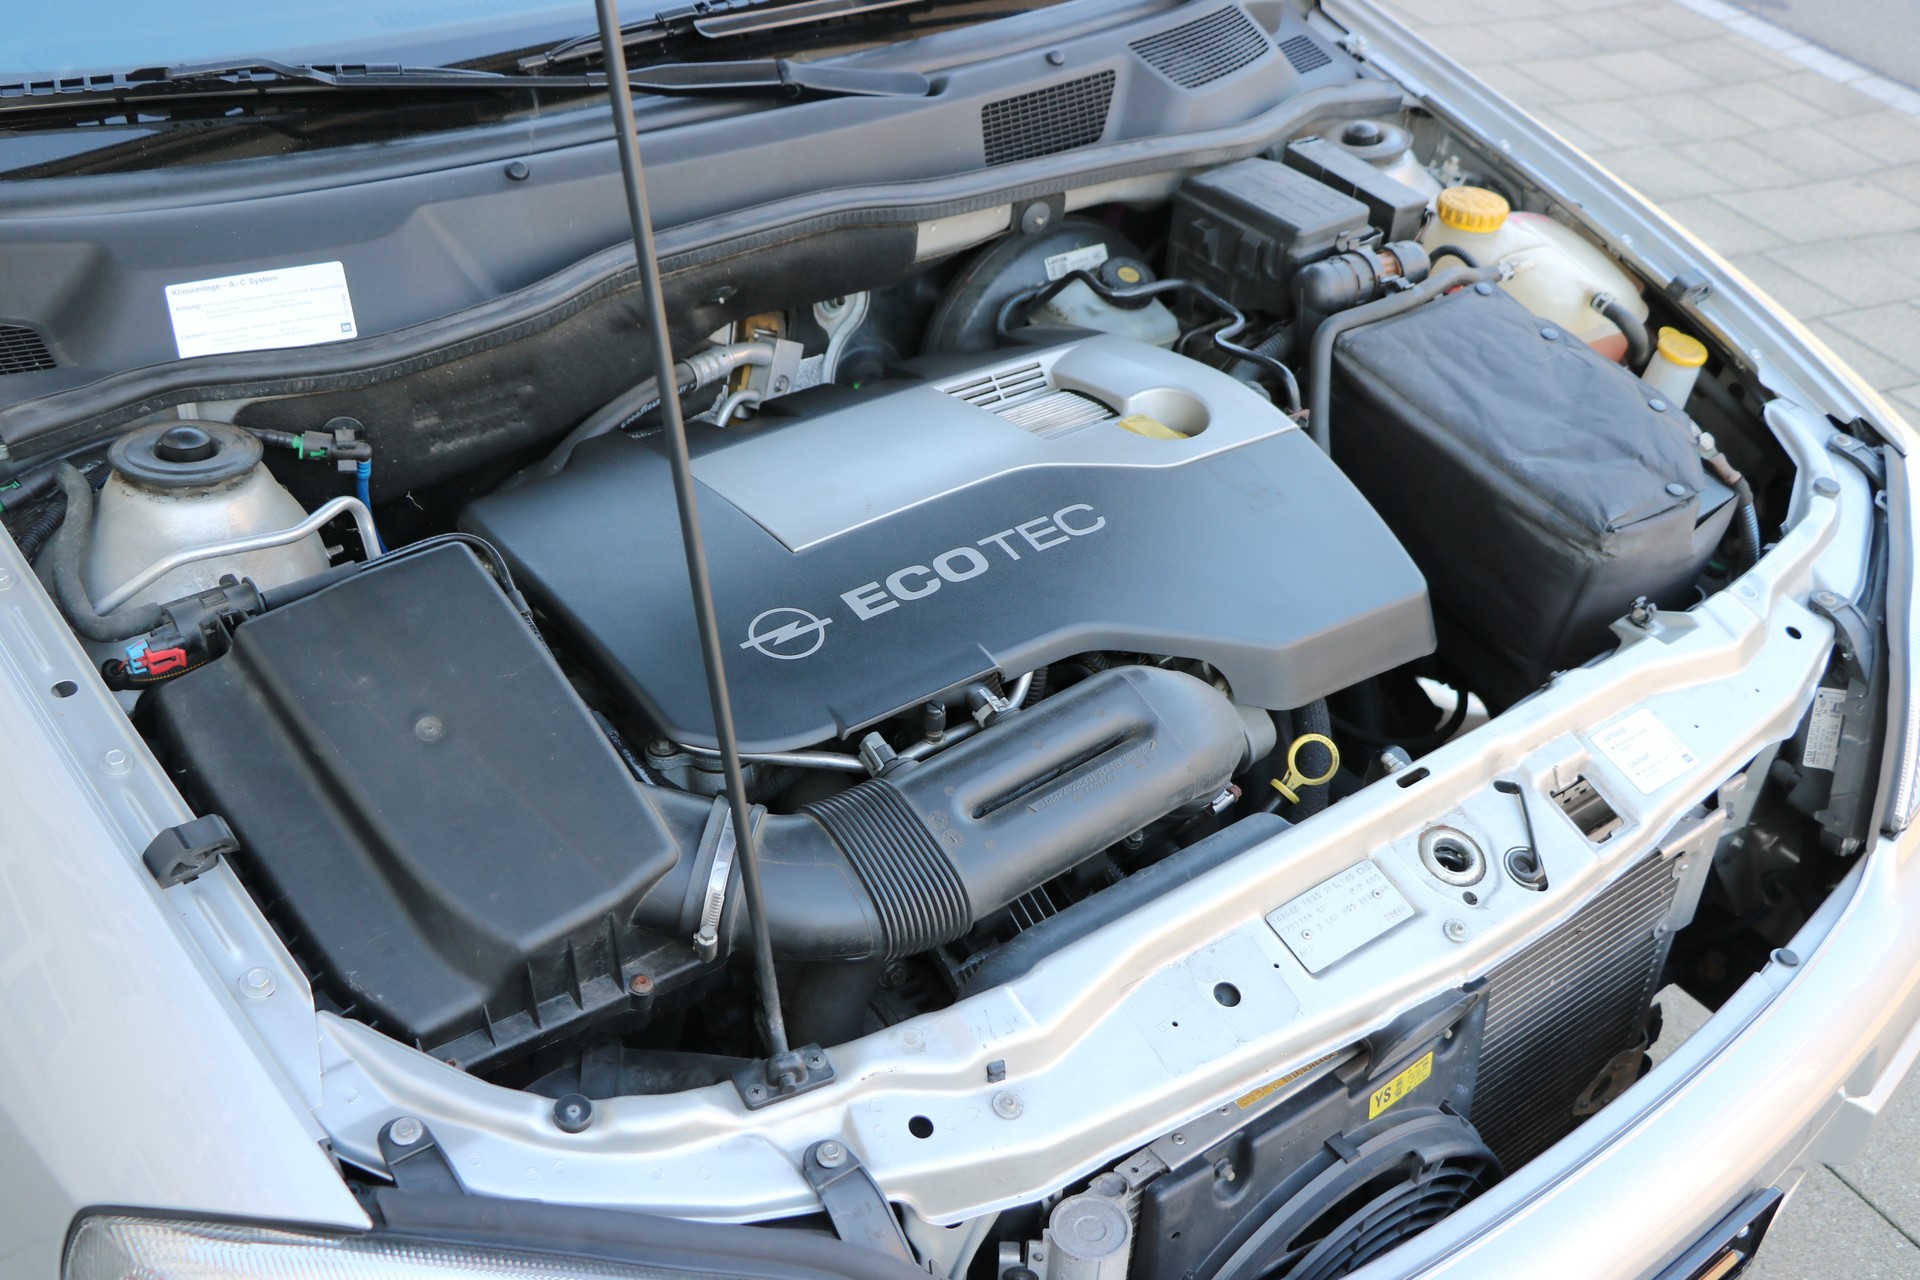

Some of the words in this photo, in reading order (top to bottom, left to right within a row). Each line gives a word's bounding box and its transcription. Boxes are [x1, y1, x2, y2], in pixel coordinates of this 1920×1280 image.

[172, 283, 220, 296] Klimaanlage
[249, 275, 278, 287] System
[840, 503, 1106, 621] ECOTEC
[1374, 1086, 1392, 1108] YS
